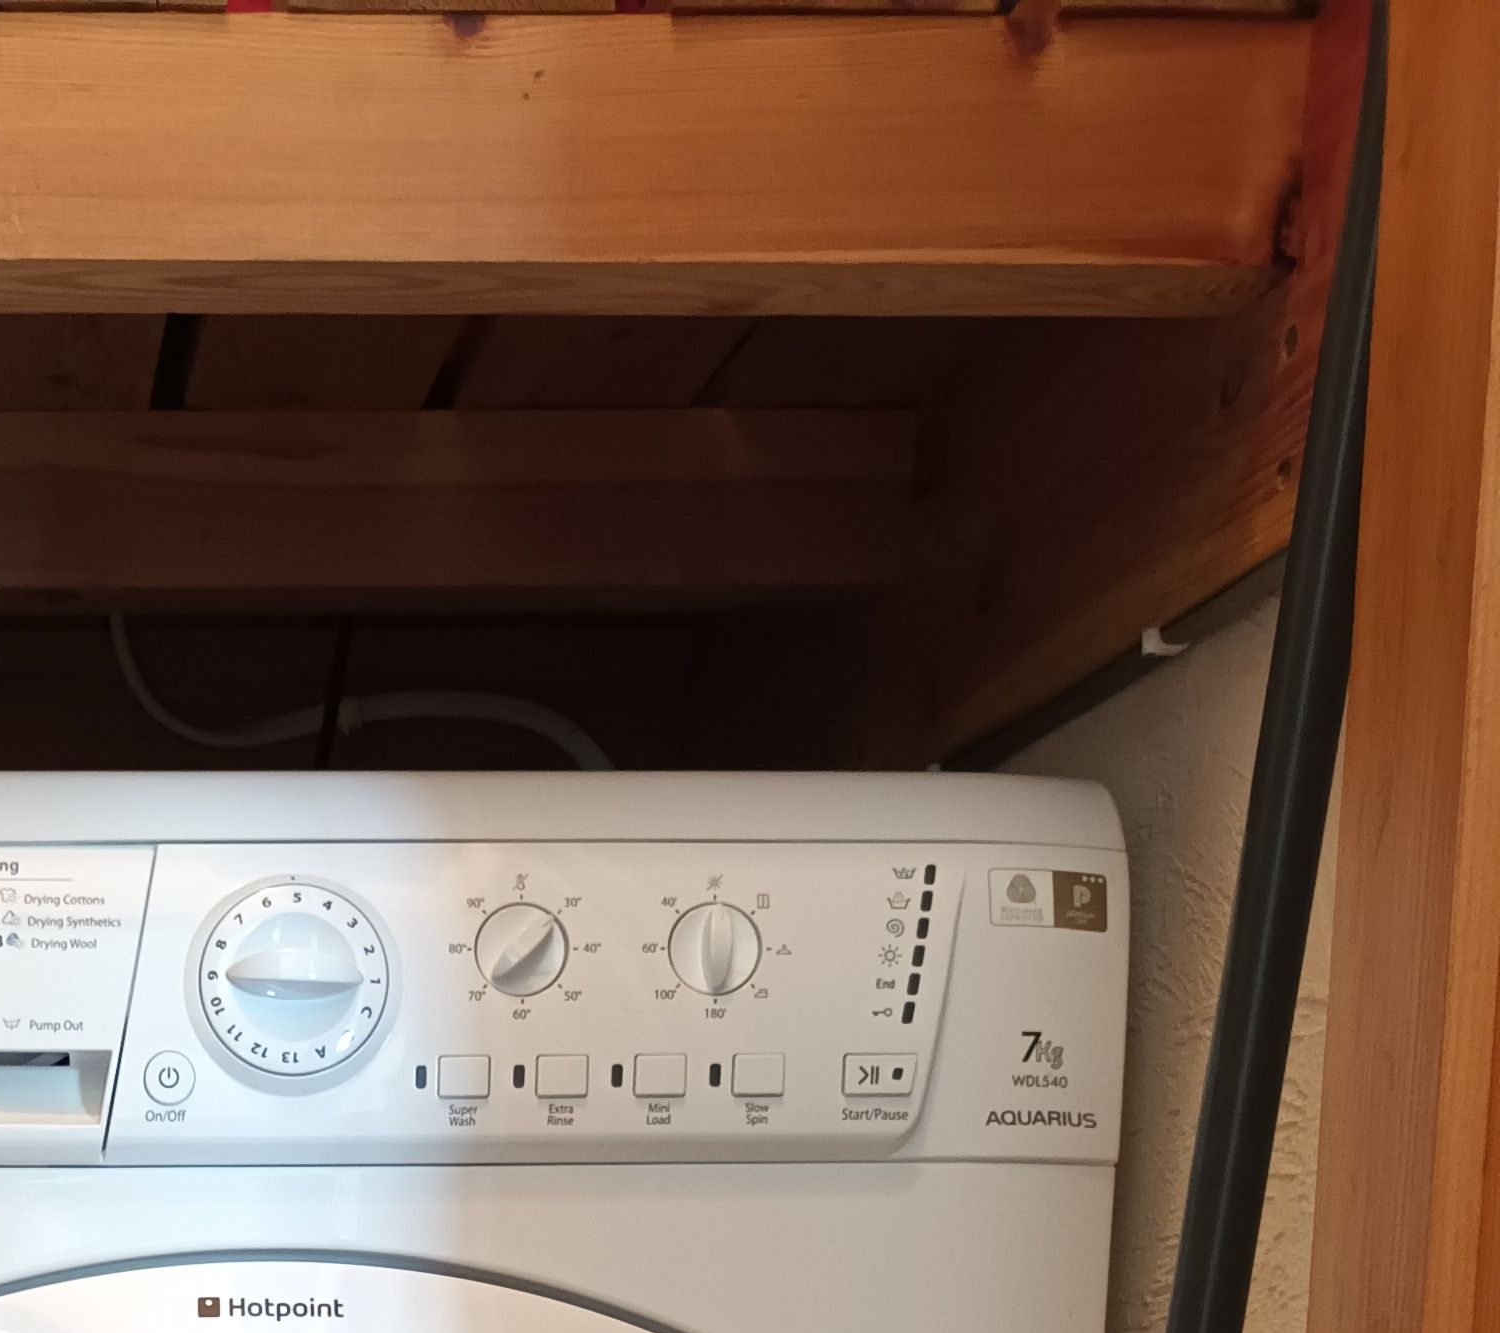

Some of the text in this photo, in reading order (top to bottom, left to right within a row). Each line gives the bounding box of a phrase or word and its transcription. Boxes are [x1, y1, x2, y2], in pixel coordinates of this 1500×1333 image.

[24, 895, 60, 907] Drying
[63, 895, 105, 905] Cottons
[262, 897, 272, 908] 6
[293, 892, 301, 903] 5
[322, 900, 333, 910] 4
[28, 916, 63, 929] Drying
[66, 916, 122, 929] Synthetics
[233, 913, 245, 925] 7
[347, 918, 358, 928] 3
[31, 938, 67, 951] Drying
[70, 938, 97, 949] Wool
[215, 939, 227, 950] 8
[363, 945, 375, 956] 2
[207, 970, 218, 980] 9
[370, 977, 380, 985] 1
[875, 978, 895, 990] End
[210, 996, 225, 1016] 10
[360, 1006, 373, 1019] C
[29, 1020, 61, 1033] Pump
[63, 1020, 83, 1031] Out
[226, 1024, 243, 1041] 11
[250, 1042, 268, 1058] 12
[314, 1045, 327, 1059] A
[281, 1051, 299, 1063] 13
[1012, 1074, 1068, 1089] WDL540
[449, 1104, 478, 1116] Super
[548, 1104, 574, 1114] Extra
[648, 1103, 670, 1114] Mini
[745, 1102, 769, 1113] Slow
[145, 1110, 187, 1122] On/Off
[547, 1115, 574, 1126] Rinse
[646, 1114, 671, 1125] Load
[746, 1114, 768, 1126] Spin
[841, 1108, 909, 1121] Start/Pause
[985, 1110, 1097, 1128] AQUARIUS
[449, 1116, 476, 1126] Wash
[229, 1297, 344, 1321] Hotpoint
